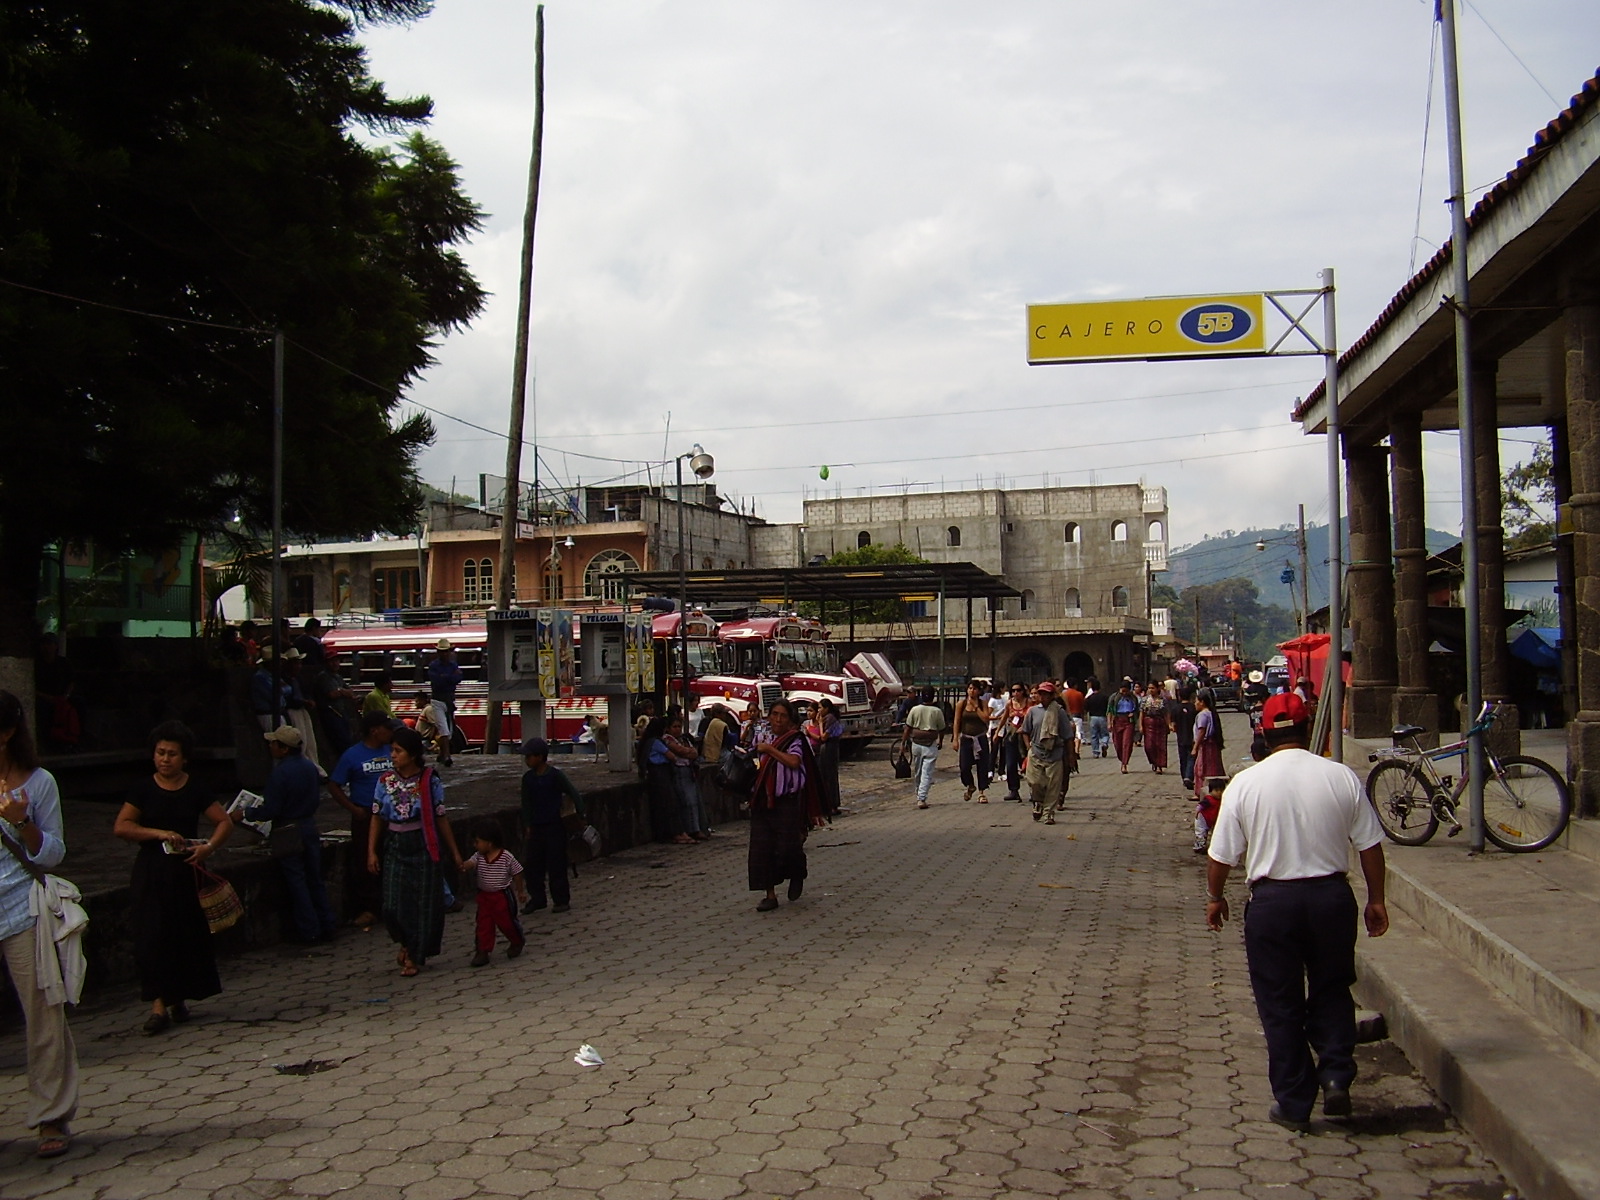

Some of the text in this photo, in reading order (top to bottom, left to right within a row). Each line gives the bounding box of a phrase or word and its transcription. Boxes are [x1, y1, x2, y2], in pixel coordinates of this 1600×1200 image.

[1035, 312, 1234, 340] CAJERO 5B
[494, 611, 530, 620] TELGUA
